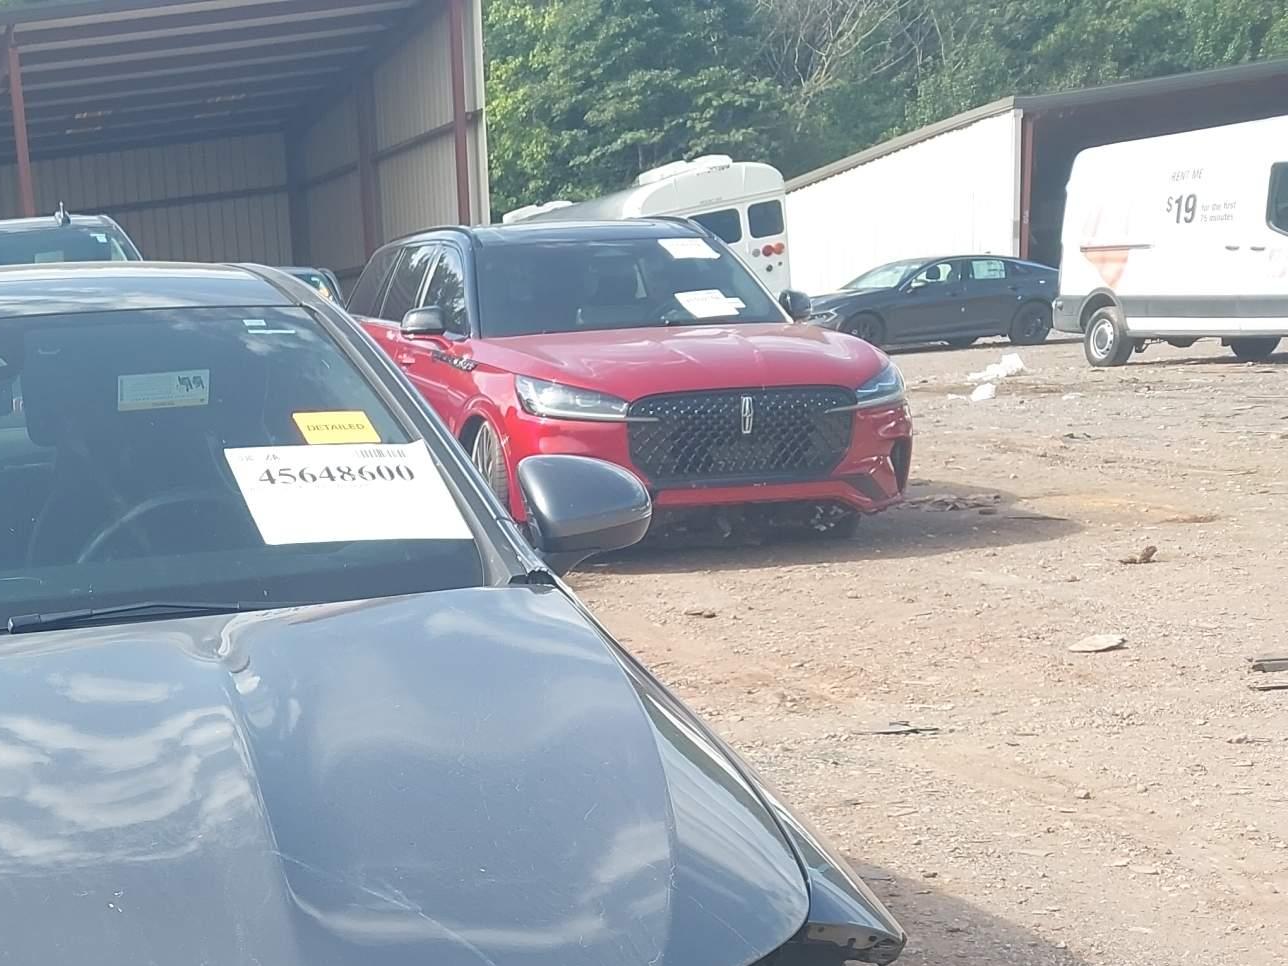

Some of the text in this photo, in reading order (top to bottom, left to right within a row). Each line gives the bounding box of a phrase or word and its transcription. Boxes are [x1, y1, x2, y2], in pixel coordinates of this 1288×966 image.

[1171, 168, 1204, 182] RENT ME
[1166, 193, 1197, 224] $19
[1223, 200, 1237, 210] first
[1209, 213, 1234, 222] minutes
[306, 422, 366, 432] DETAILED
[258, 464, 416, 485] 45648600
